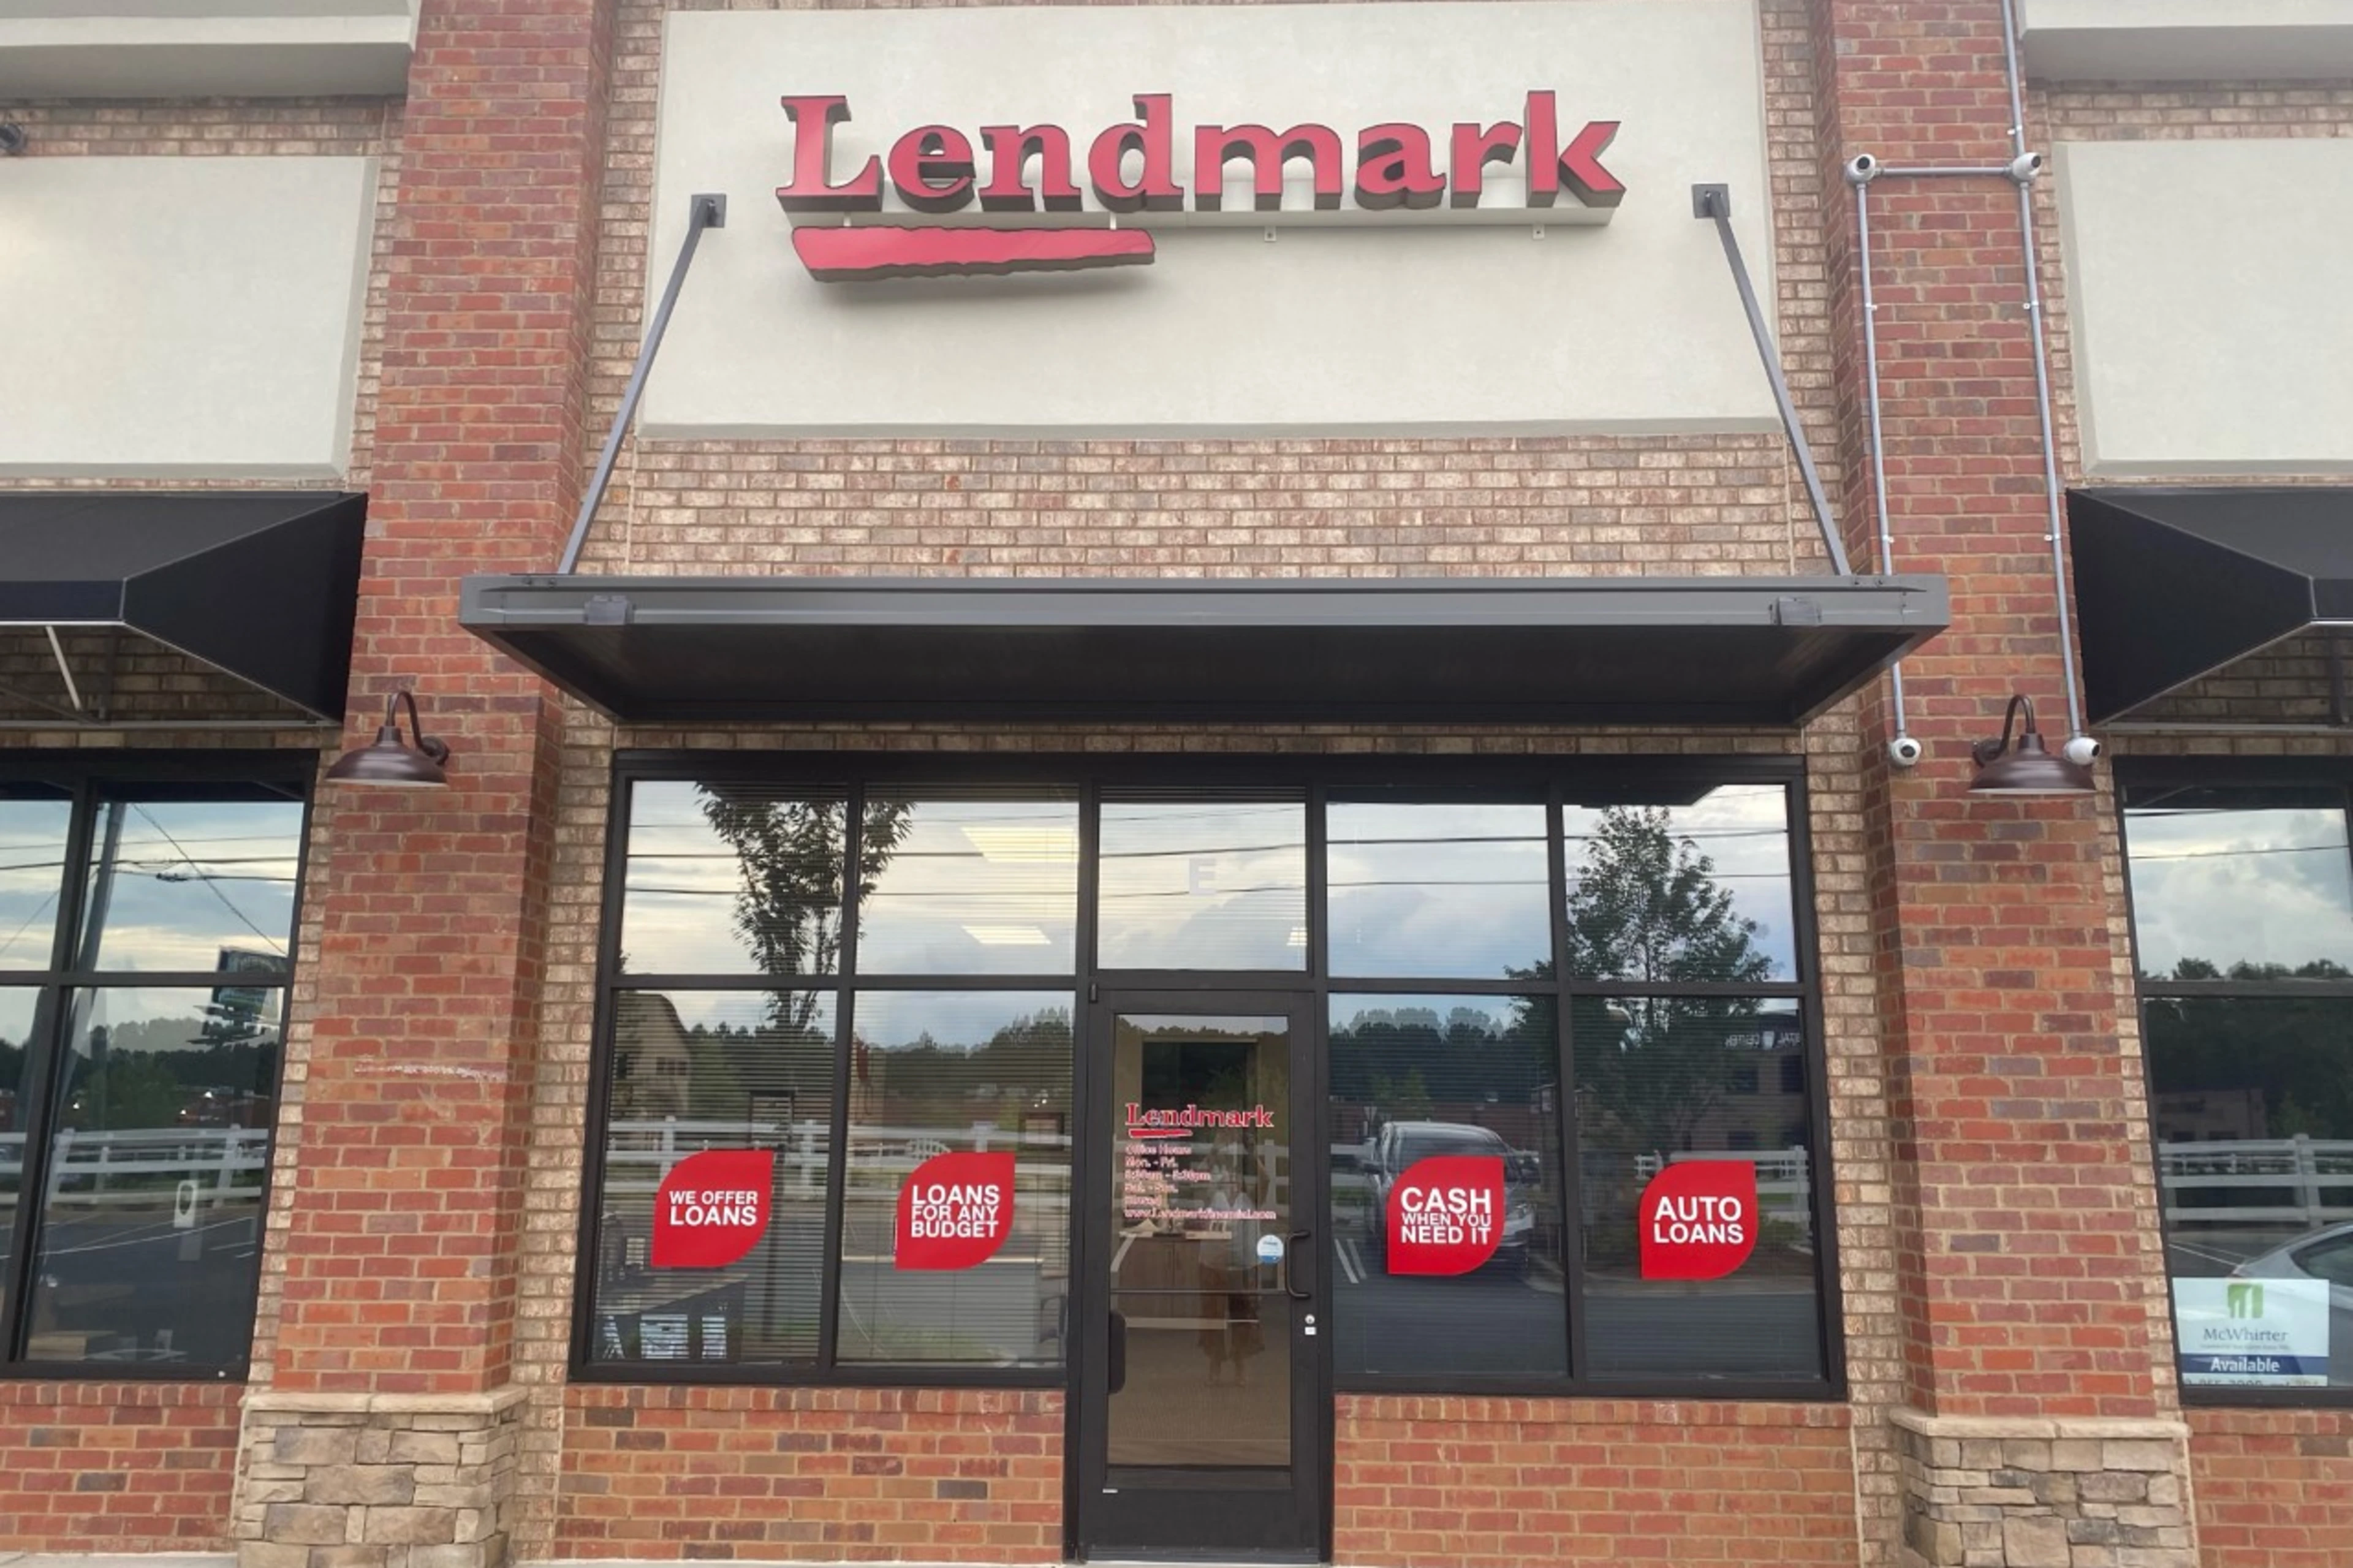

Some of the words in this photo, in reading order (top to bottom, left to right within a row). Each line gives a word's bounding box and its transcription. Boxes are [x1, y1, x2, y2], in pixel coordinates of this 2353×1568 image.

[776, 89, 1626, 213] Lendmark
[1189, 858, 1216, 896] E
[1125, 1103, 1275, 1127] Lendmark
[669, 1191, 696, 1205] WE
[702, 1191, 758, 1205] OFFER
[911, 1184, 1000, 1205] LOANS
[1401, 1186, 1491, 1214] CASH
[669, 1205, 757, 1226] LOANS
[911, 1205, 951, 1221] FOR
[957, 1205, 999, 1221] ANY
[1654, 1196, 1742, 1222] AUTO
[911, 1221, 999, 1238] BUDGET
[1401, 1213, 1451, 1226] WHEN
[1456, 1213, 1491, 1227] YOU
[1401, 1226, 1464, 1244] NEED
[1471, 1227, 1491, 1244] IT
[1654, 1222, 1744, 1244] LOANS
[2203, 1327, 2289, 1342] McWhirter
[2210, 1356, 2280, 1372] Available
